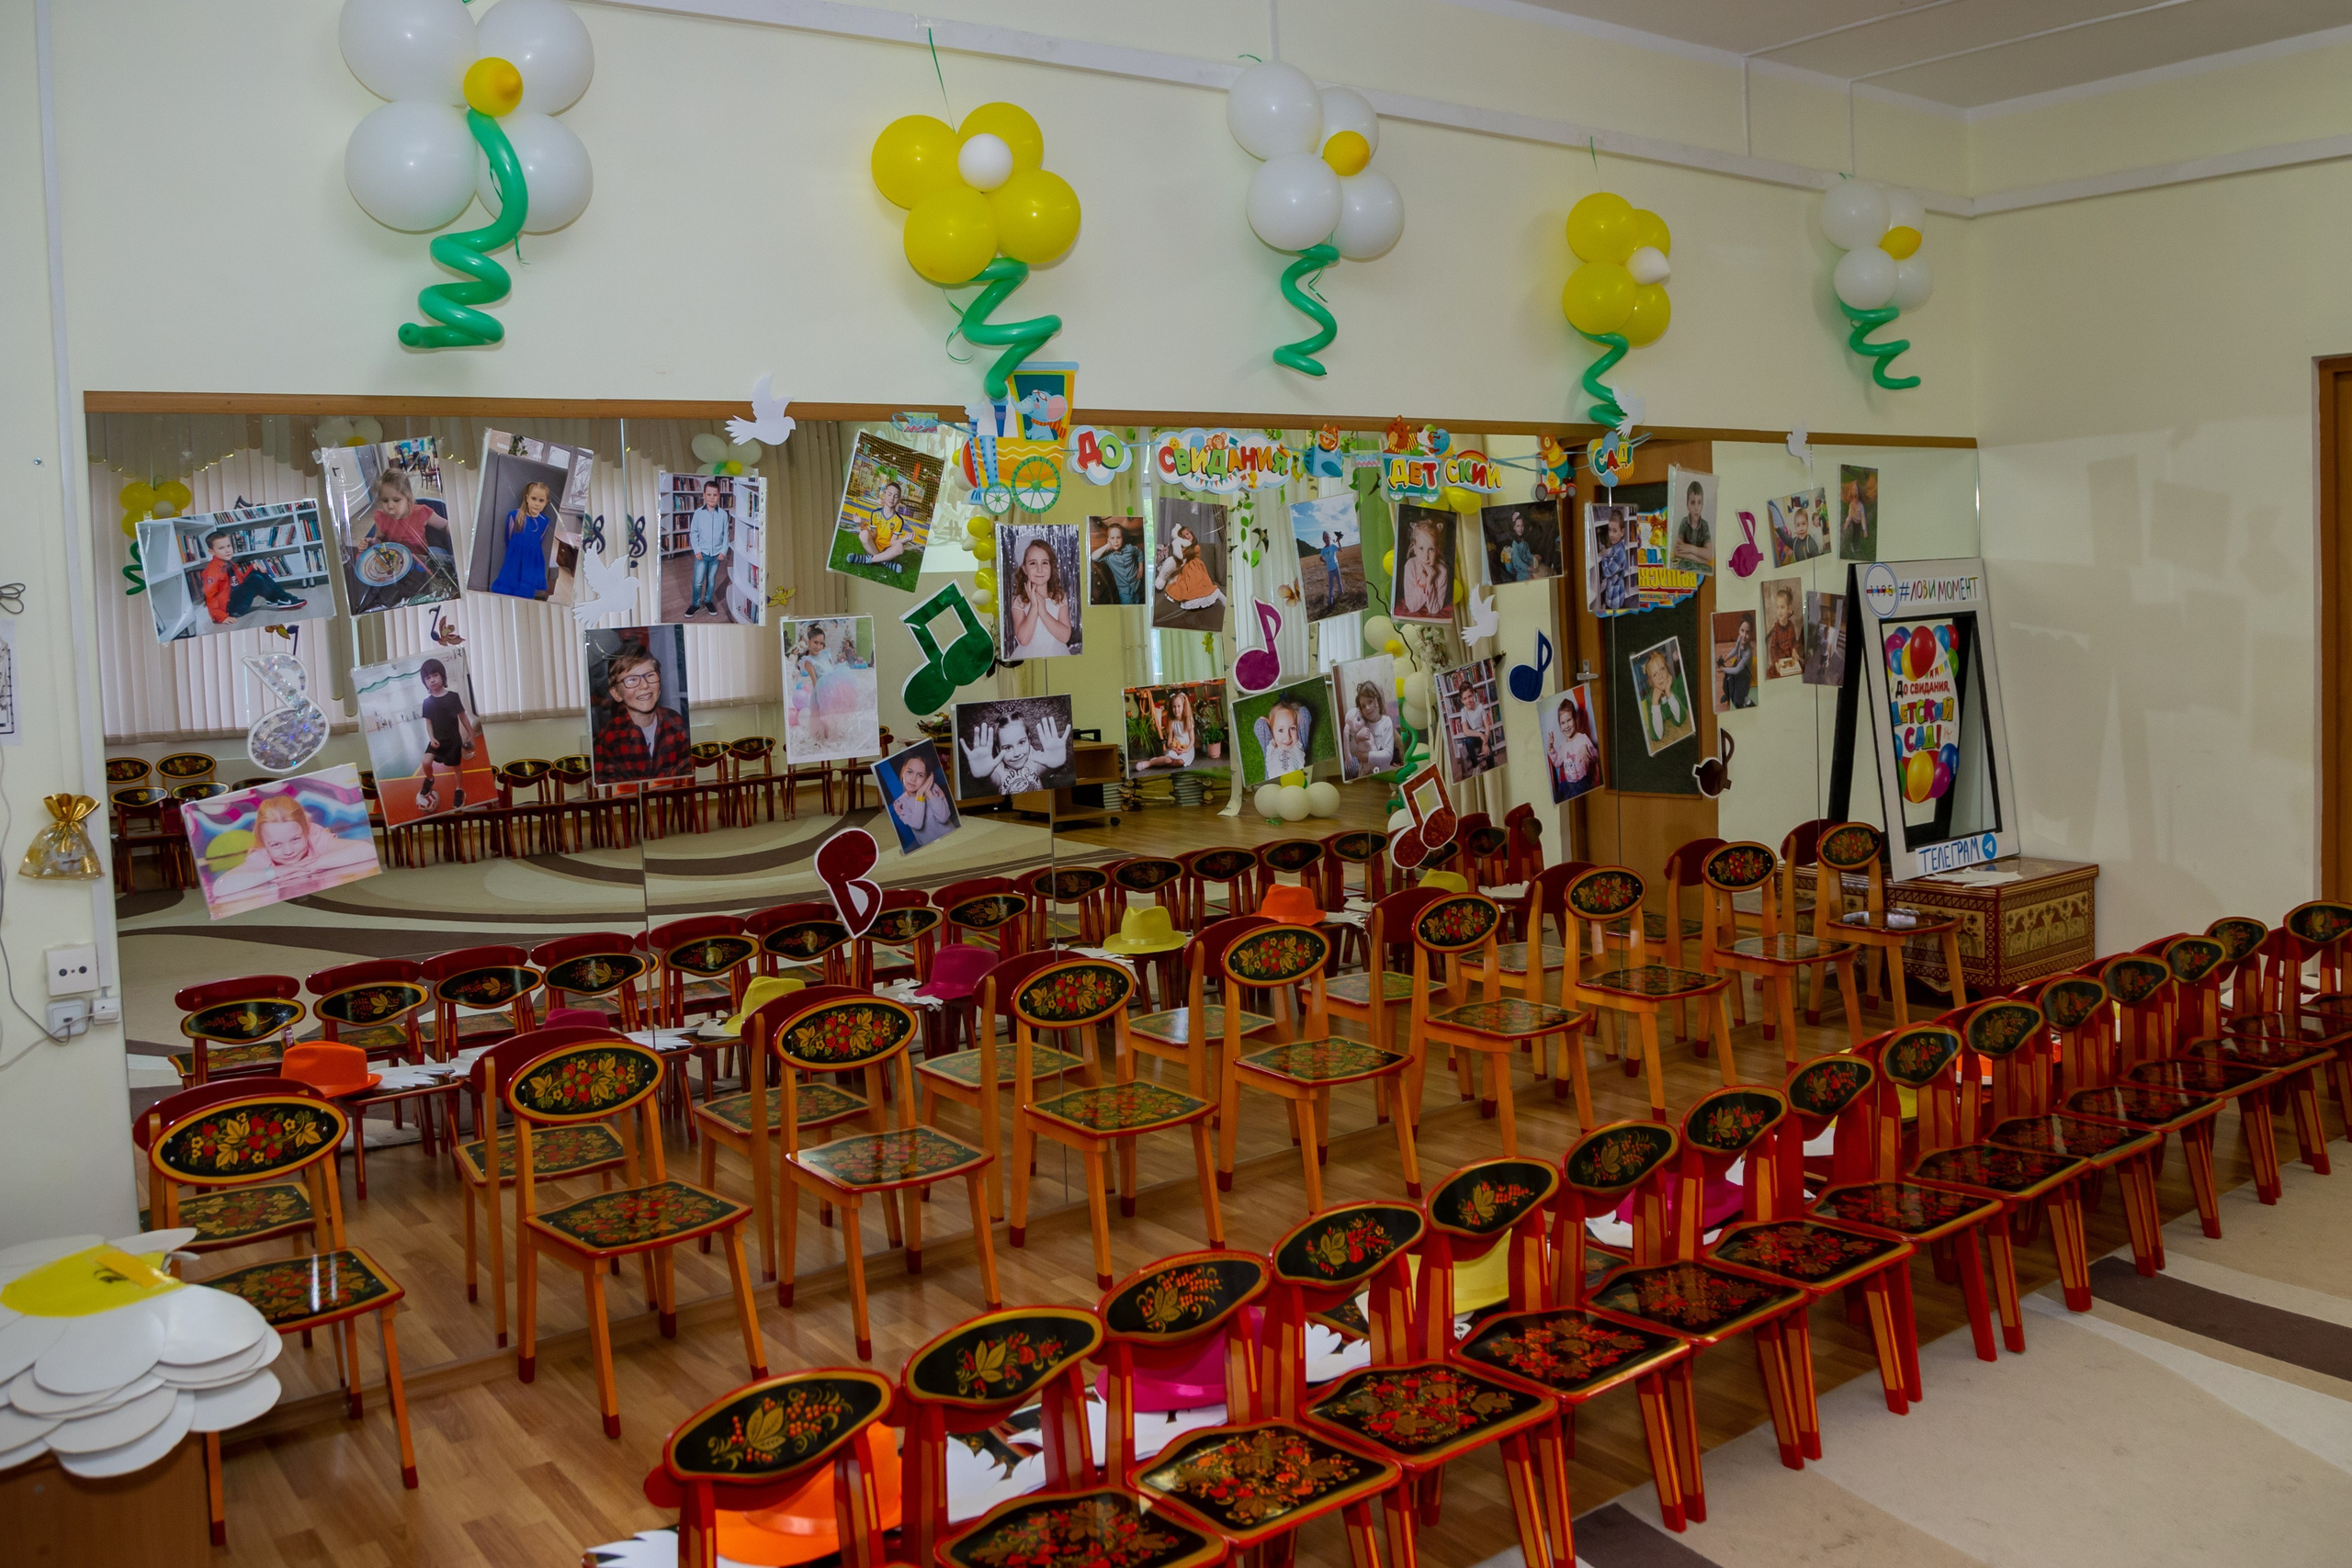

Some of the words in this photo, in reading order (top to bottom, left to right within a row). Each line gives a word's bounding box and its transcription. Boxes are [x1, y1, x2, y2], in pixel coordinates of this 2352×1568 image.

[1078, 431, 1125, 471] ДО
[1870, 584, 1894, 597] 1195
[1904, 724, 1942, 752] САД!
[1918, 837, 1981, 874] ТЕЛЕГРАМ
